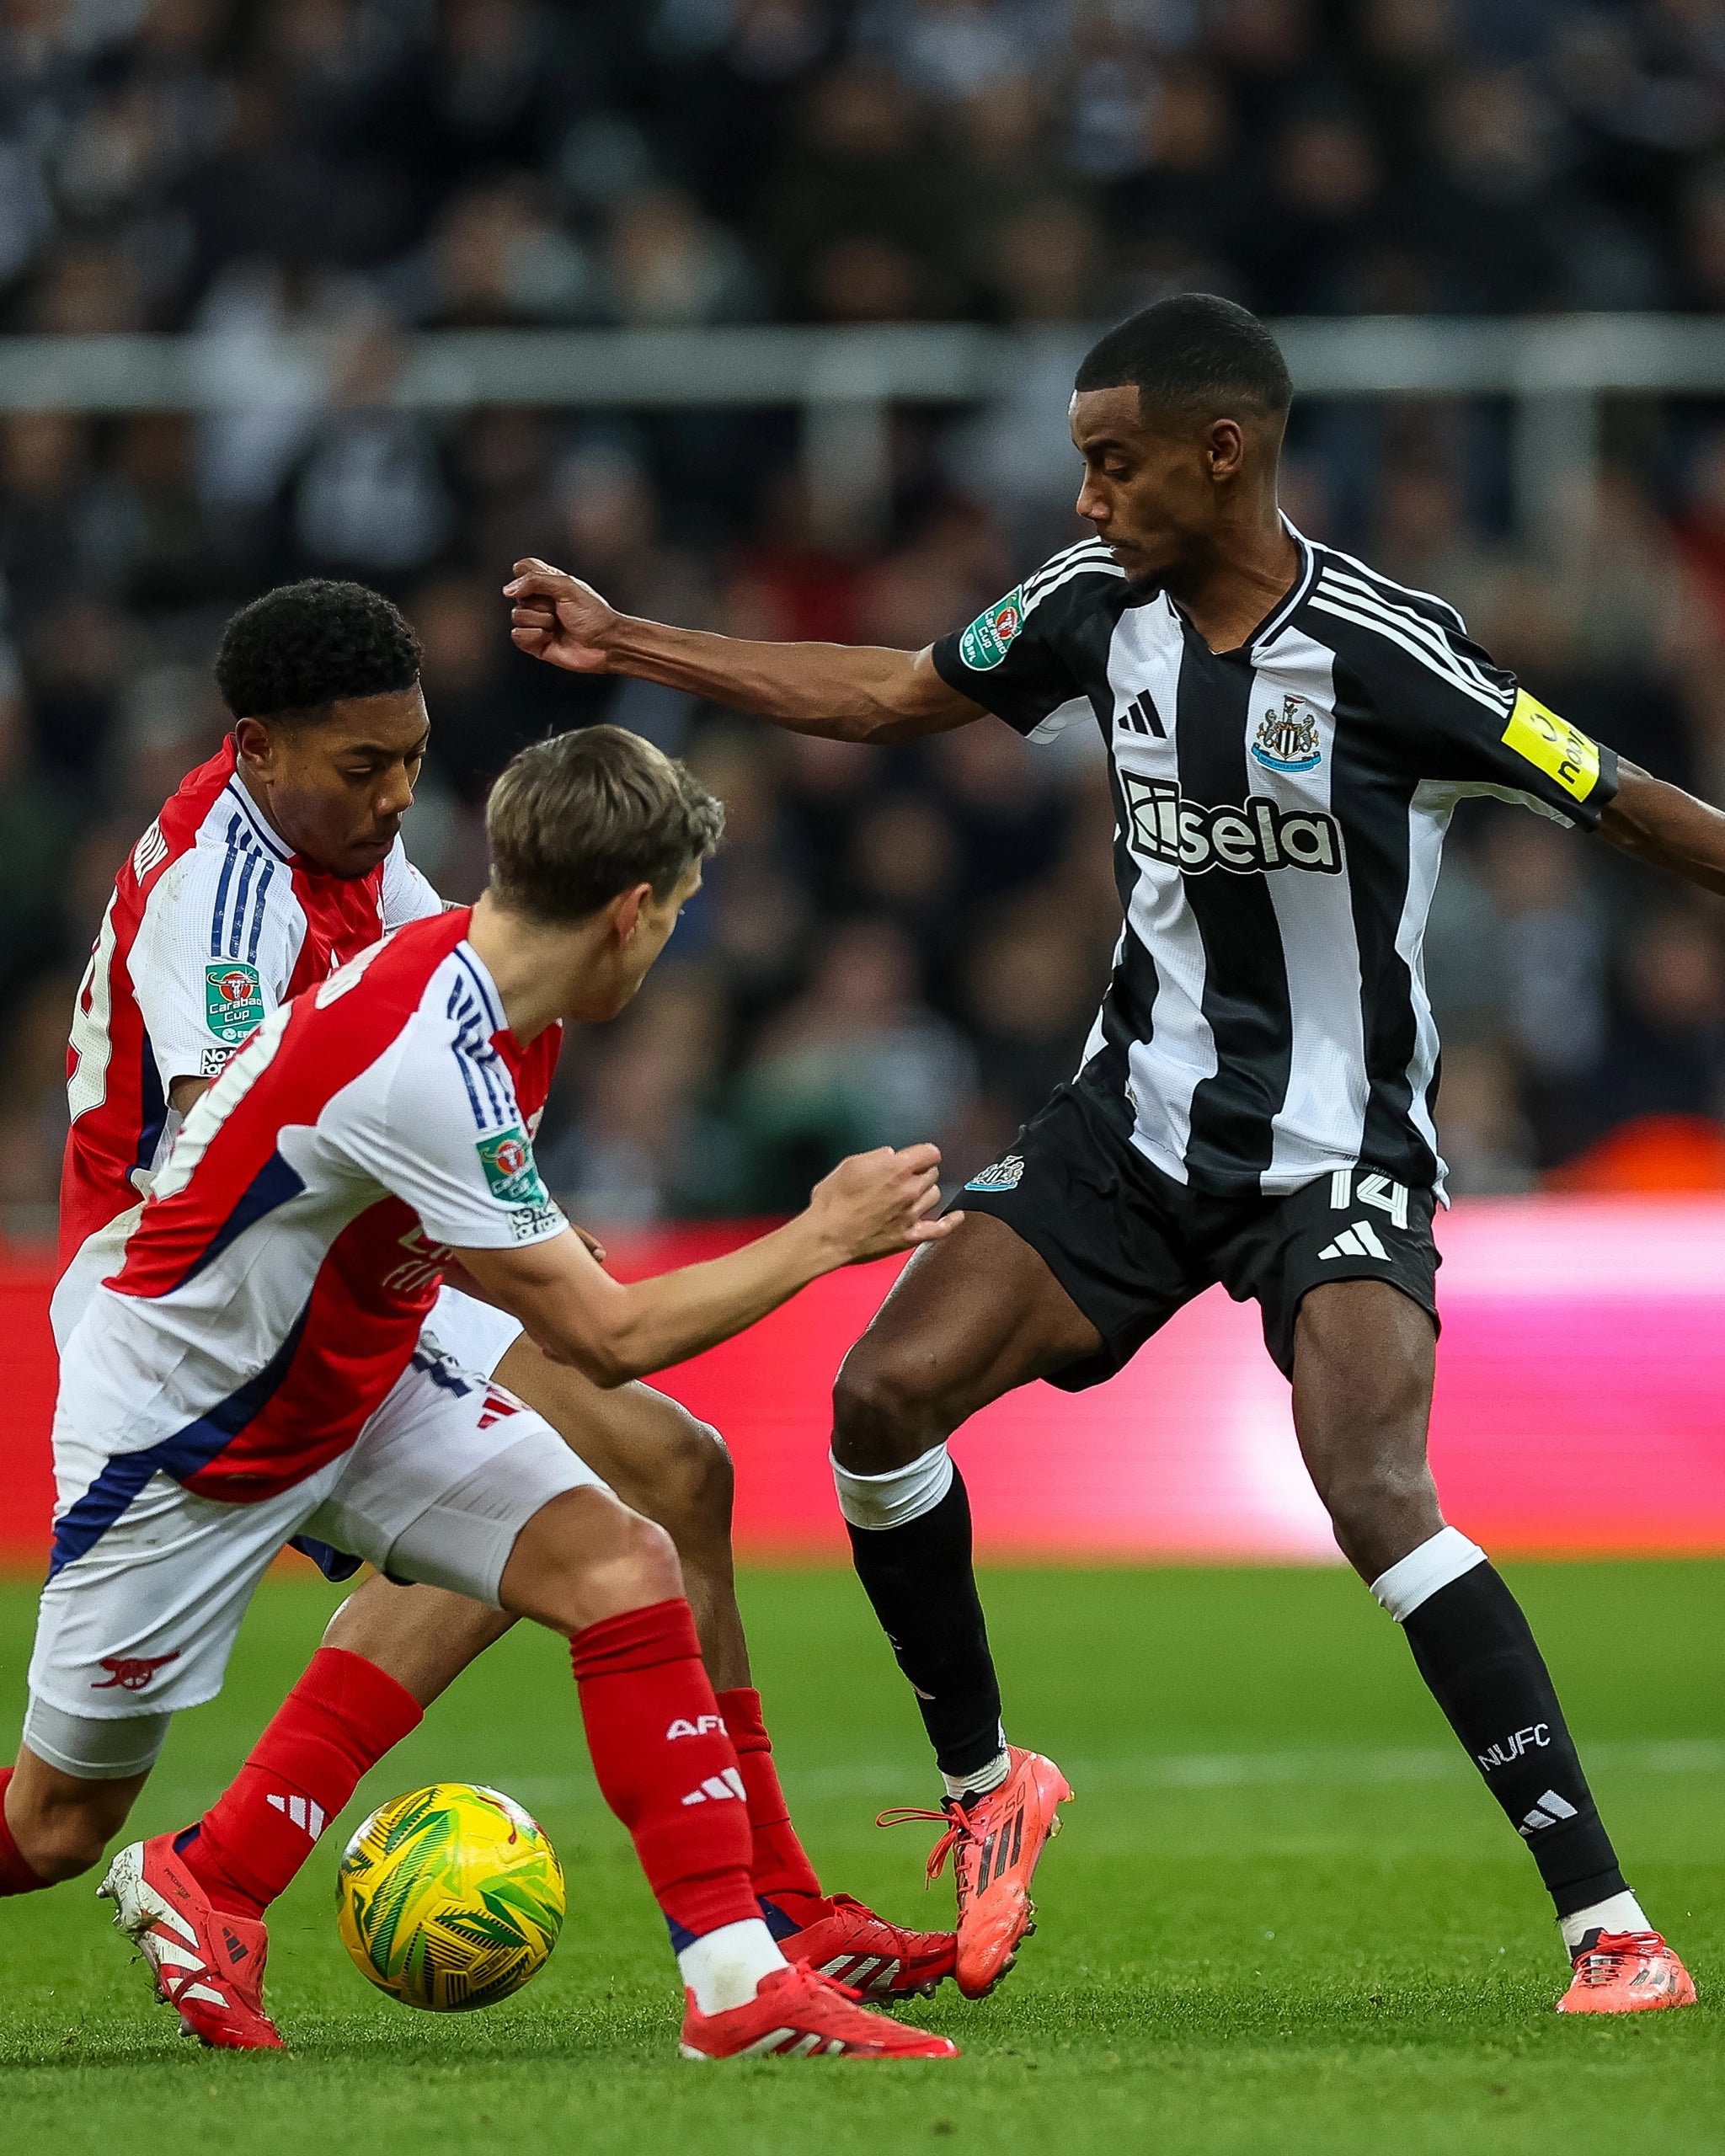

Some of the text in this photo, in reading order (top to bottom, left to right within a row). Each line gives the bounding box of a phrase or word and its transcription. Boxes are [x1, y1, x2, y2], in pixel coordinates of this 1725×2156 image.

[978, 626, 993, 648] Cup
[985, 610, 1007, 654] Carabao
[1178, 804, 1334, 866] sela
[209, 996, 263, 1015] Carabao
[224, 1009, 250, 1023] Cup
[237, 1030, 250, 1038] EF
[1330, 1170, 1409, 1230] 14
[1477, 1722, 1551, 1772] NUFC
